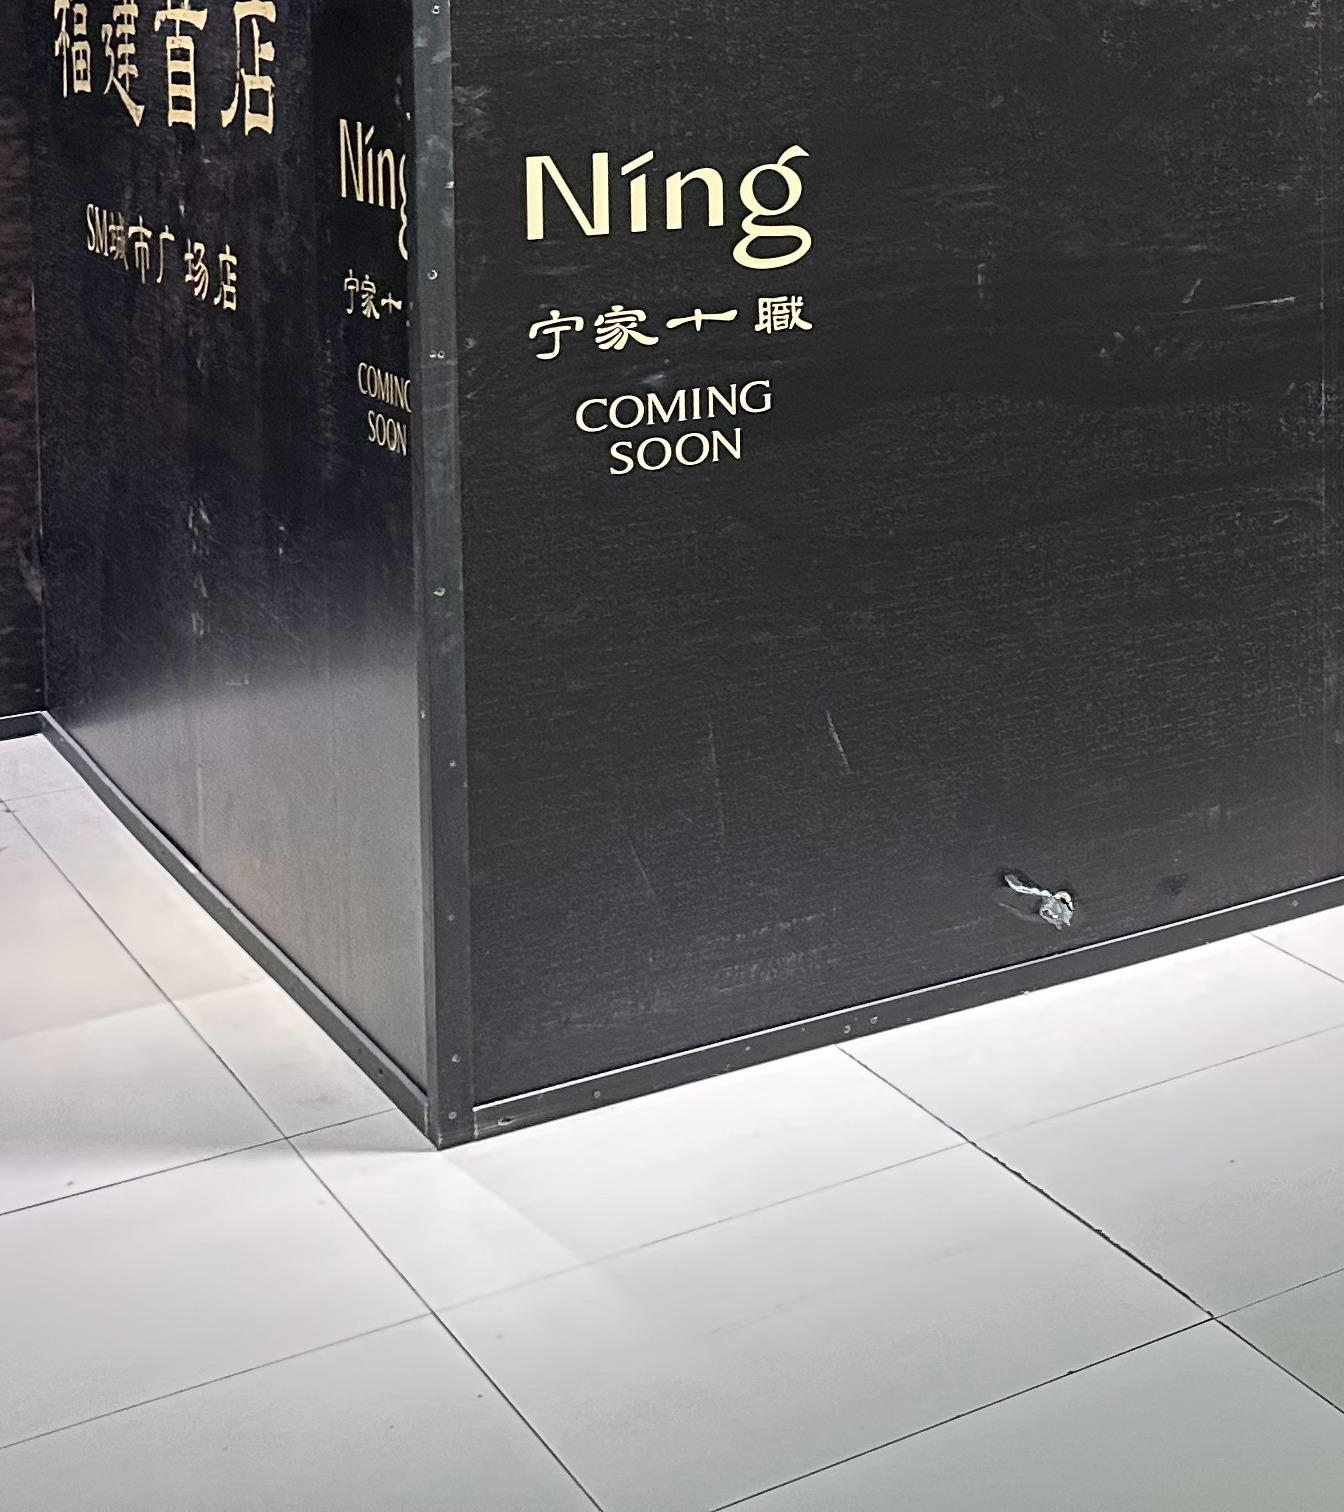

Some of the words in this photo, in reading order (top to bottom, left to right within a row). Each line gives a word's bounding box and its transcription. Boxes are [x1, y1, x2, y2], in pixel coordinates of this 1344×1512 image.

[86, 203, 238, 311] SM城市广场店
[575, 380, 772, 433] COMING
[368, 410, 406, 455] SOON
[609, 427, 742, 475] SOON
